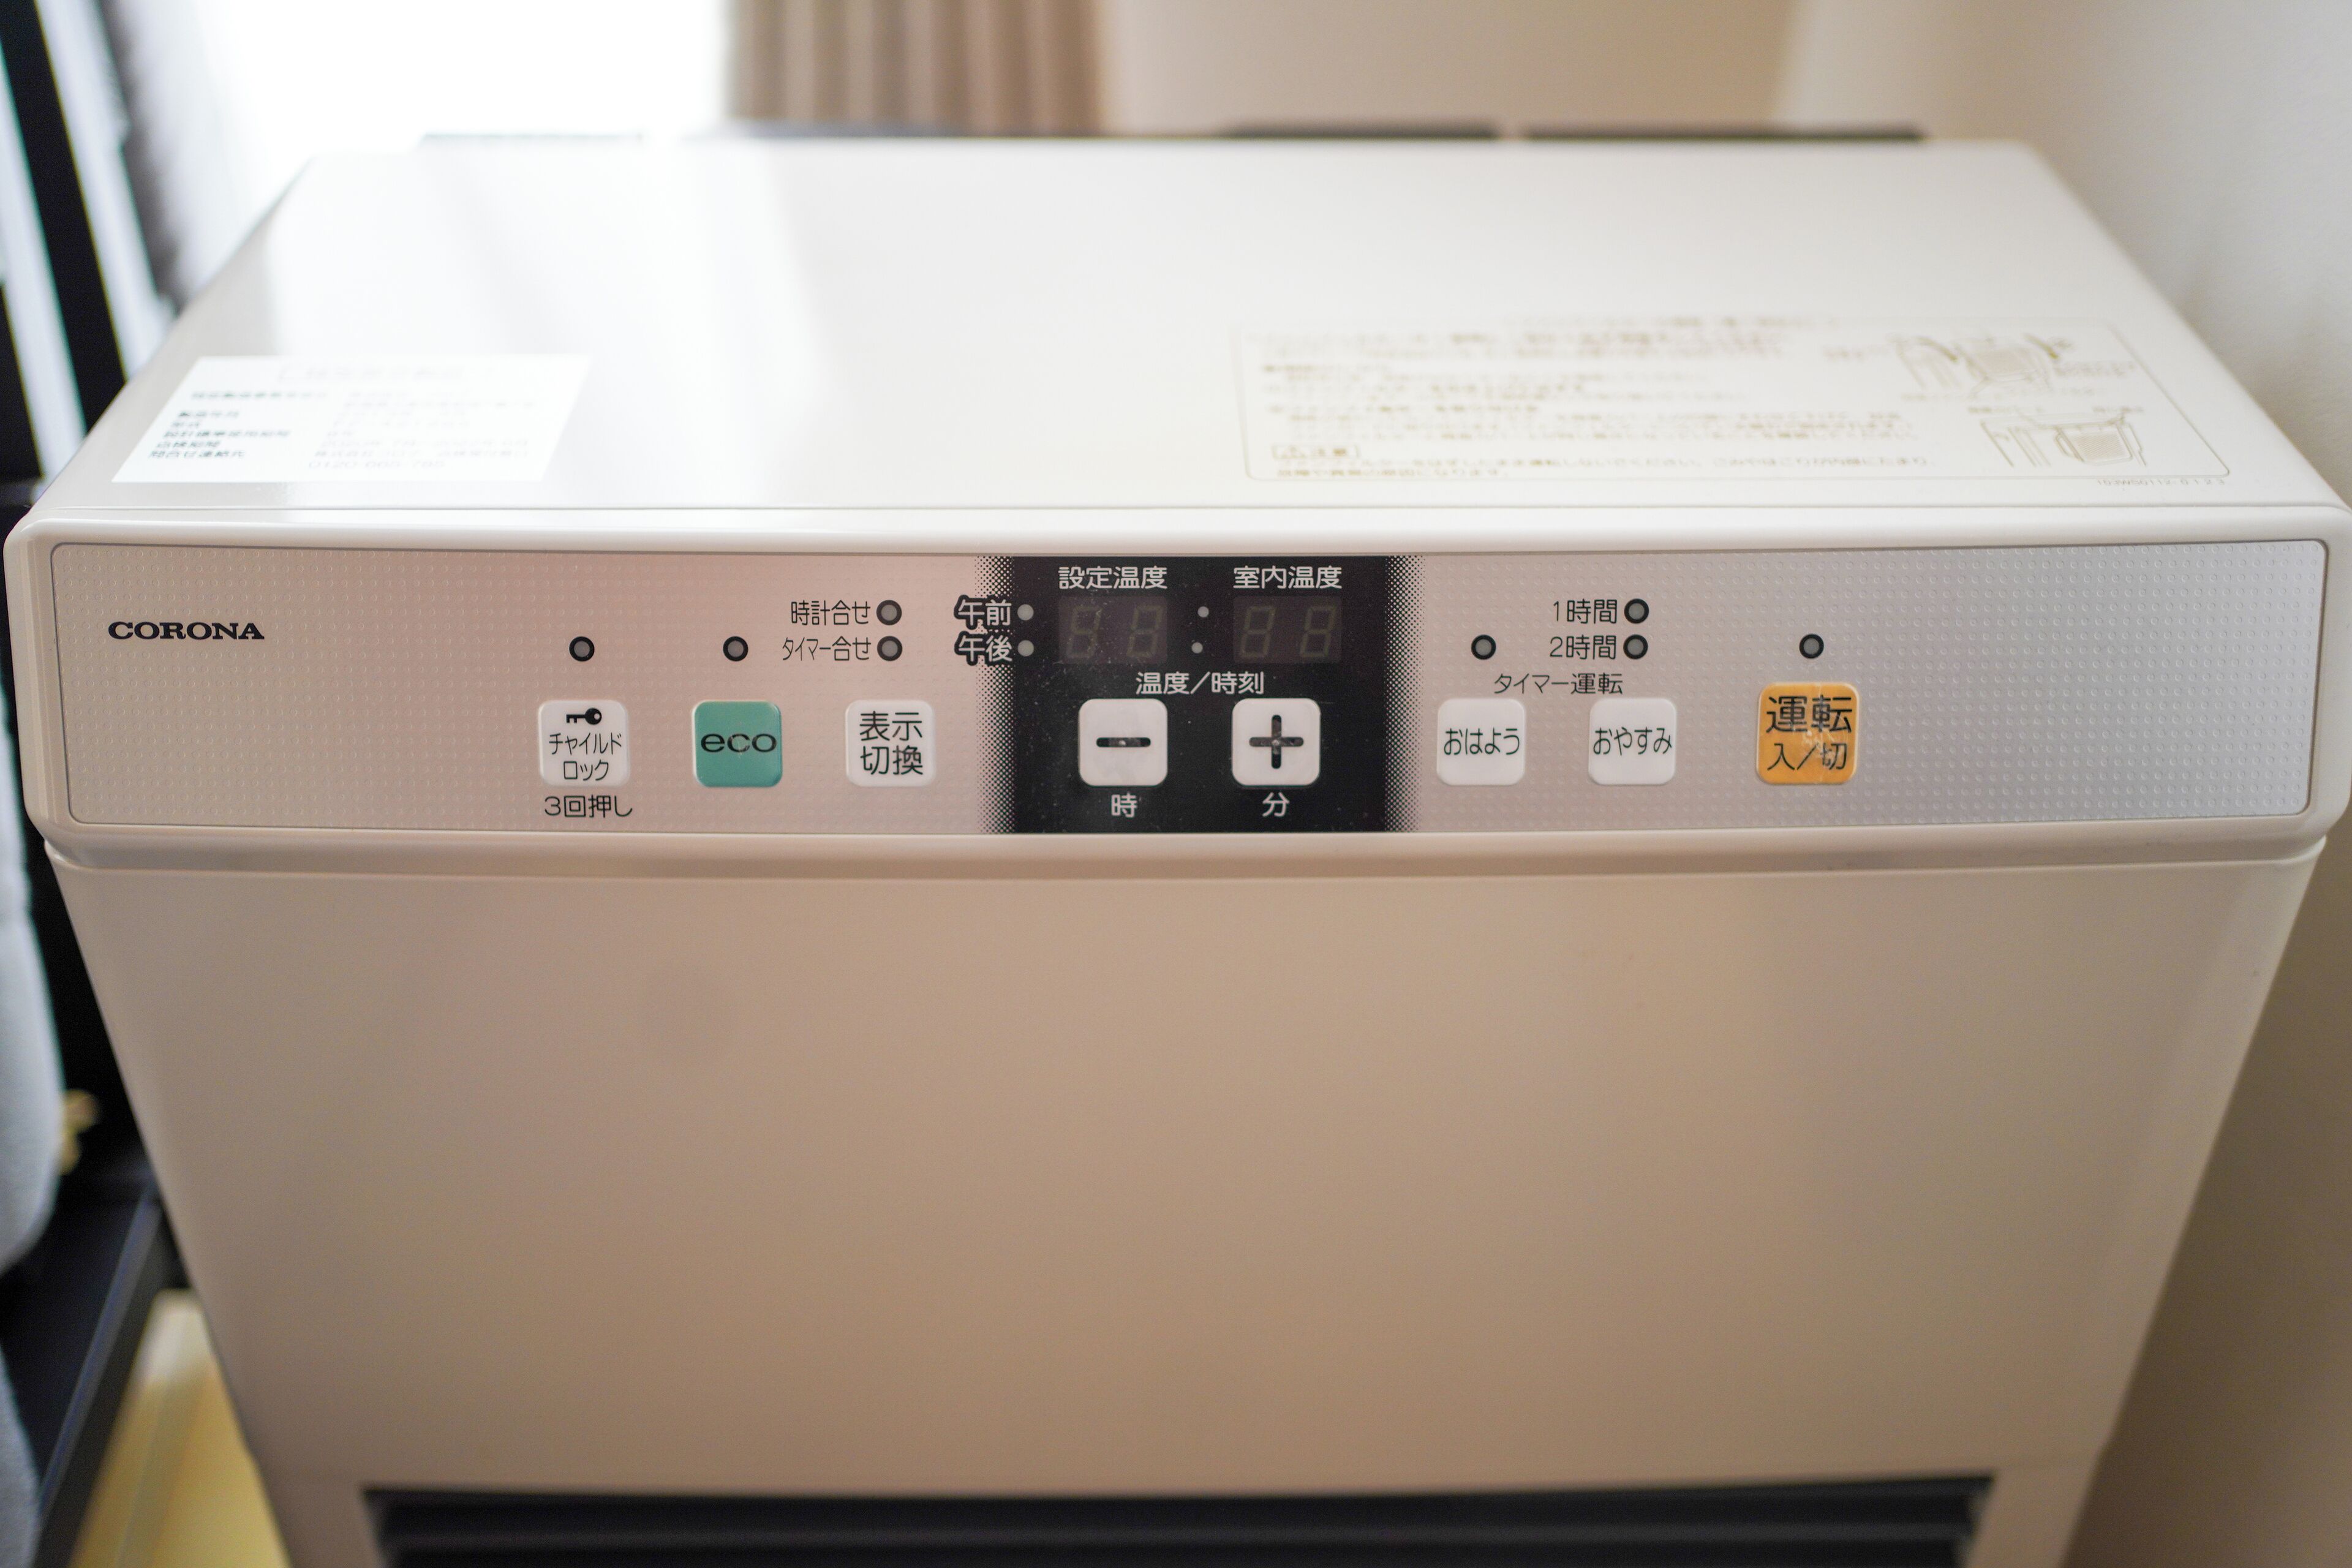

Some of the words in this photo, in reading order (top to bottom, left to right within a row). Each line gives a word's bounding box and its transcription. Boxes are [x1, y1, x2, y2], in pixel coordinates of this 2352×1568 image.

[1058, 566, 1167, 589] 設定温度
[1234, 566, 1341, 589] 室内温度
[791, 600, 870, 625] 時計合せ
[957, 599, 1012, 626] 午前
[1554, 599, 1617, 624] 1時間
[108, 622, 264, 639] CORONA
[783, 636, 871, 661] タイマー合せ
[958, 635, 1012, 662] 午後
[1550, 635, 1616, 659] 2時間
[1494, 673, 1623, 694] タイマー運転
[1766, 695, 1852, 732] 運転
[860, 711, 922, 741] 表示
[549, 733, 621, 755] チャイルド
[701, 734, 776, 752] eco
[1444, 728, 1519, 755] おはよう
[1594, 727, 1672, 755] おやすみ
[564, 760, 608, 780] ロック
[861, 745, 922, 775] 切換
[545, 795, 632, 818] 3回押し
[1112, 793, 1137, 817] 時
[1263, 793, 1289, 816] 分
